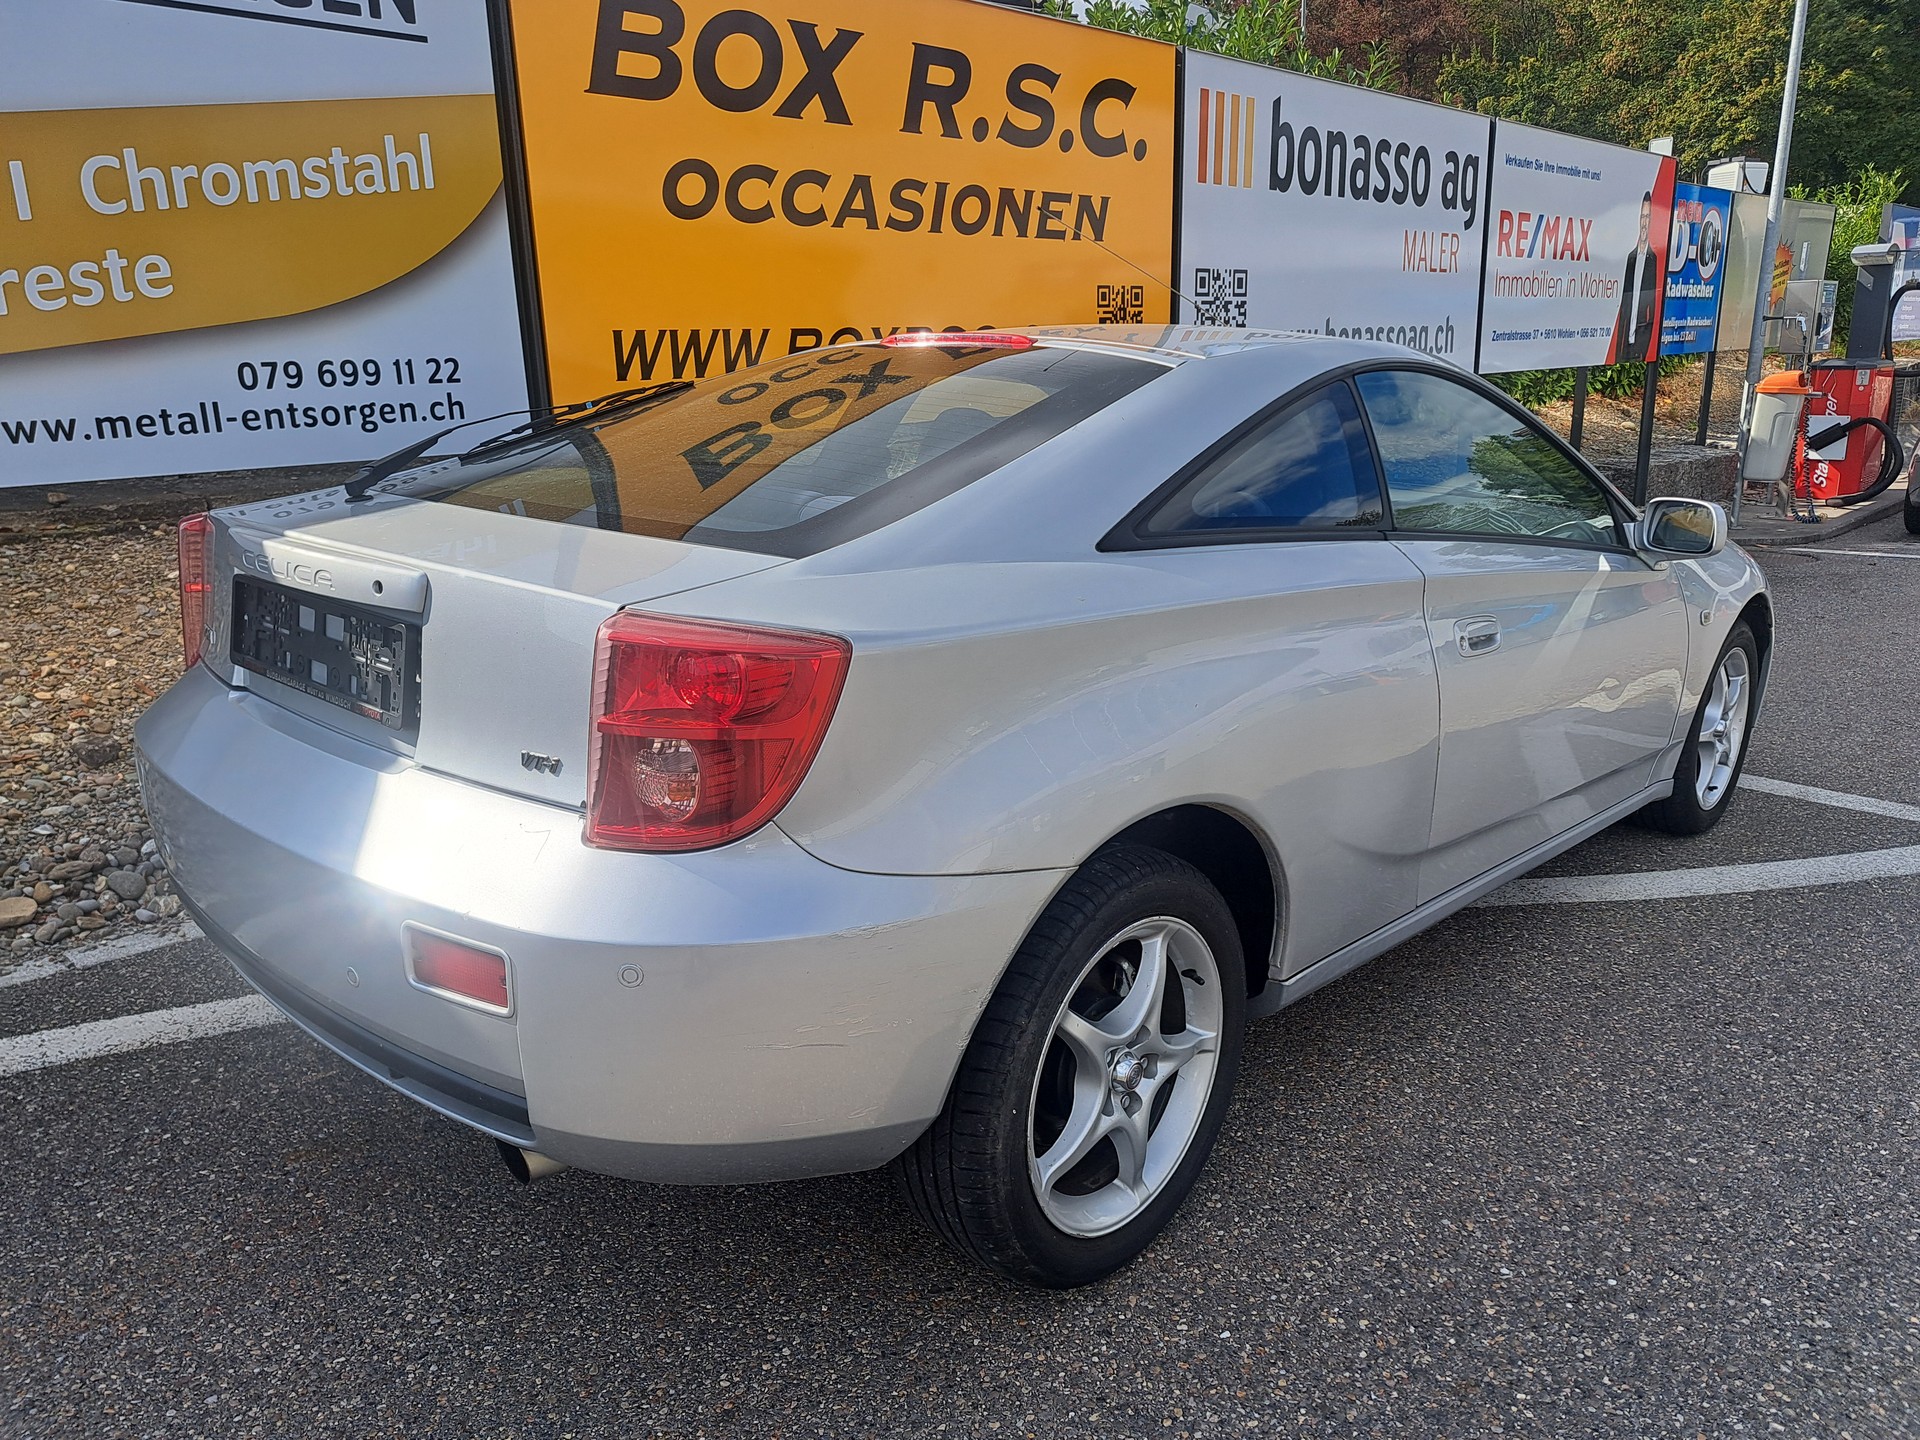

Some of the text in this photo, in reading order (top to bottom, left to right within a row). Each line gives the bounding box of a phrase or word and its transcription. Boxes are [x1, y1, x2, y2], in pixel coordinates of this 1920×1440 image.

[584, 0, 1149, 162] BOX R.S.C.
[79, 132, 435, 215] Chromstahl
[1269, 95, 1480, 231] bonasso ag
[1505, 153, 1602, 181] Verkaufen Sie Ihre Immobilie mit uns!
[661, 158, 1112, 242] OCCASIONEN
[1402, 229, 1460, 274] MALER
[1496, 209, 1594, 262] RE/MAX
[1494, 268, 1619, 299] Immobilien in Wohlen
[1666, 278, 1715, 298] Radwäscher
[1491, 330, 1532, 342] Zentralstrasse
[1532, 329, 1540, 340] 37
[1544, 328, 1557, 340] 5610
[1557, 328, 1576, 339] Wohlen
[238, 358, 462, 391] 079 699 11 22
[242, 549, 336, 591] CELICA
